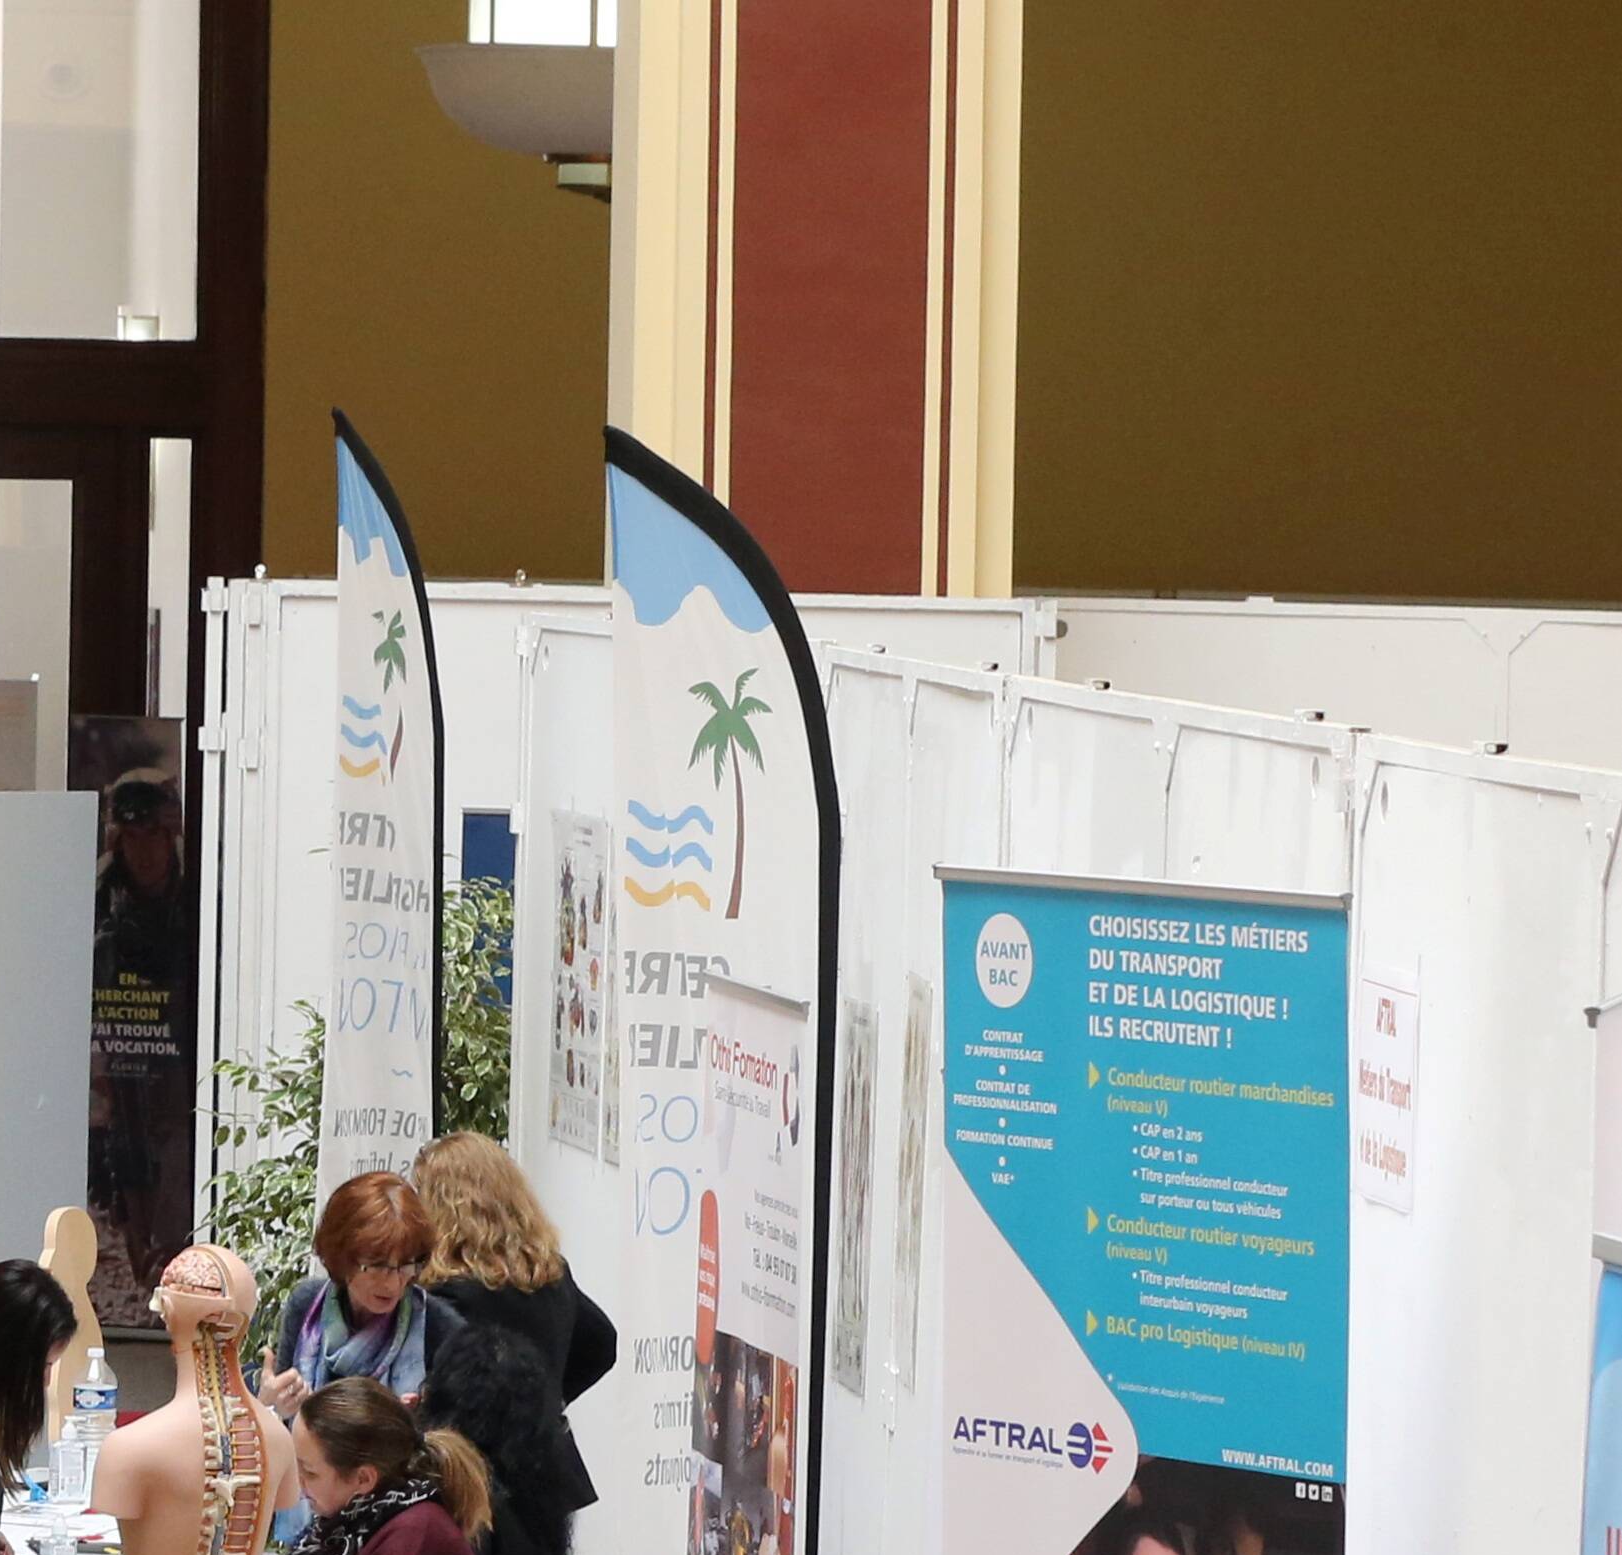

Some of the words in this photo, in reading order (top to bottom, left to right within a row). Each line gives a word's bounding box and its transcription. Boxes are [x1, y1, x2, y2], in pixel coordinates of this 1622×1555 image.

[1089, 915, 1190, 943] CHOISISSEZ
[1195, 924, 1226, 946] LES
[1230, 923, 1308, 952] MÉTIERS
[980, 940, 1027, 961] AVANT
[1089, 949, 1113, 970] DU
[1120, 951, 1222, 980] TRANSPORT
[119, 973, 137, 985] EN
[988, 968, 1018, 987] BAC
[93, 989, 170, 1004] HERCHANT
[1089, 982, 1108, 1003] ET
[1114, 984, 1137, 1006] DE
[1143, 986, 1166, 1008] LA
[1171, 988, 1276, 1019] LOGISTIQUE
[1282, 999, 1288, 1019] !
[99, 1006, 159, 1021] L'ACTION
[93, 1023, 111, 1035] 'AI
[114, 1022, 171, 1038] TROUVÉ
[982, 1029, 1023, 1044] CONTRAT
[1089, 1016, 1113, 1038] ILS
[1120, 1018, 1220, 1048] RECRUTENT
[1226, 1027, 1232, 1049] !
[105, 1041, 180, 1056] VOCATION.
[965, 1044, 1044, 1062] D'APPRENTISSAGE
[733, 1041, 778, 1090] Formation
[975, 1080, 1015, 1094] CONTRAT
[1018, 1084, 1030, 1095] DE
[1108, 1067, 1186, 1093] Conducteur
[1190, 1077, 1236, 1097] routier
[1240, 1082, 1334, 1107] marchandises
[953, 1094, 1057, 1114] PROFESSIONNALISATION
[1107, 1095, 1152, 1116] (niveau
[1155, 1099, 1168, 1117] V)
[956, 1130, 1005, 1145] FORMATION
[1007, 1135, 1053, 1150] CONTINUE
[1140, 1122, 1161, 1137] CAP
[1162, 1128, 1175, 1140] en
[1176, 1126, 1182, 1140] 2
[1185, 1129, 1203, 1142] ans
[1140, 1145, 1161, 1159] CAP
[1162, 1149, 1175, 1162] en
[1185, 1152, 1198, 1164] an
[1140, 1167, 1163, 1183] Titre
[1165, 1170, 1231, 1191] professionnel
[1233, 1180, 1289, 1197] conducteur
[1140, 1193, 1156, 1205] sur
[1158, 1193, 1194, 1210] porteur
[1196, 1198, 1209, 1211] ou
[1212, 1199, 1234, 1213] tous
[1237, 1200, 1282, 1219] véhicules
[1107, 1214, 1186, 1240] Conducteur
[1190, 1225, 1238, 1247] routier
[1241, 1235, 1315, 1257] voyageurs
[1107, 1241, 1152, 1262] (niveau
[1155, 1247, 1168, 1265] V)
[1140, 1269, 1163, 1286] Titre
[1164, 1272, 1231, 1294] professionnel
[1232, 1283, 1288, 1301] conducteur
[1140, 1292, 1194, 1312] interurbain
[1196, 1300, 1248, 1319] voyageurs
[1106, 1316, 1136, 1336] BAC
[1140, 1323, 1163, 1341] pro
[1167, 1323, 1238, 1352] Logistique
[1242, 1335, 1287, 1357] (niveau
[1288, 1342, 1306, 1361] IV)
[953, 1415, 1063, 1455] AFTRAL
[1221, 1449, 1333, 1478] WWW.AFTRAL.COM
